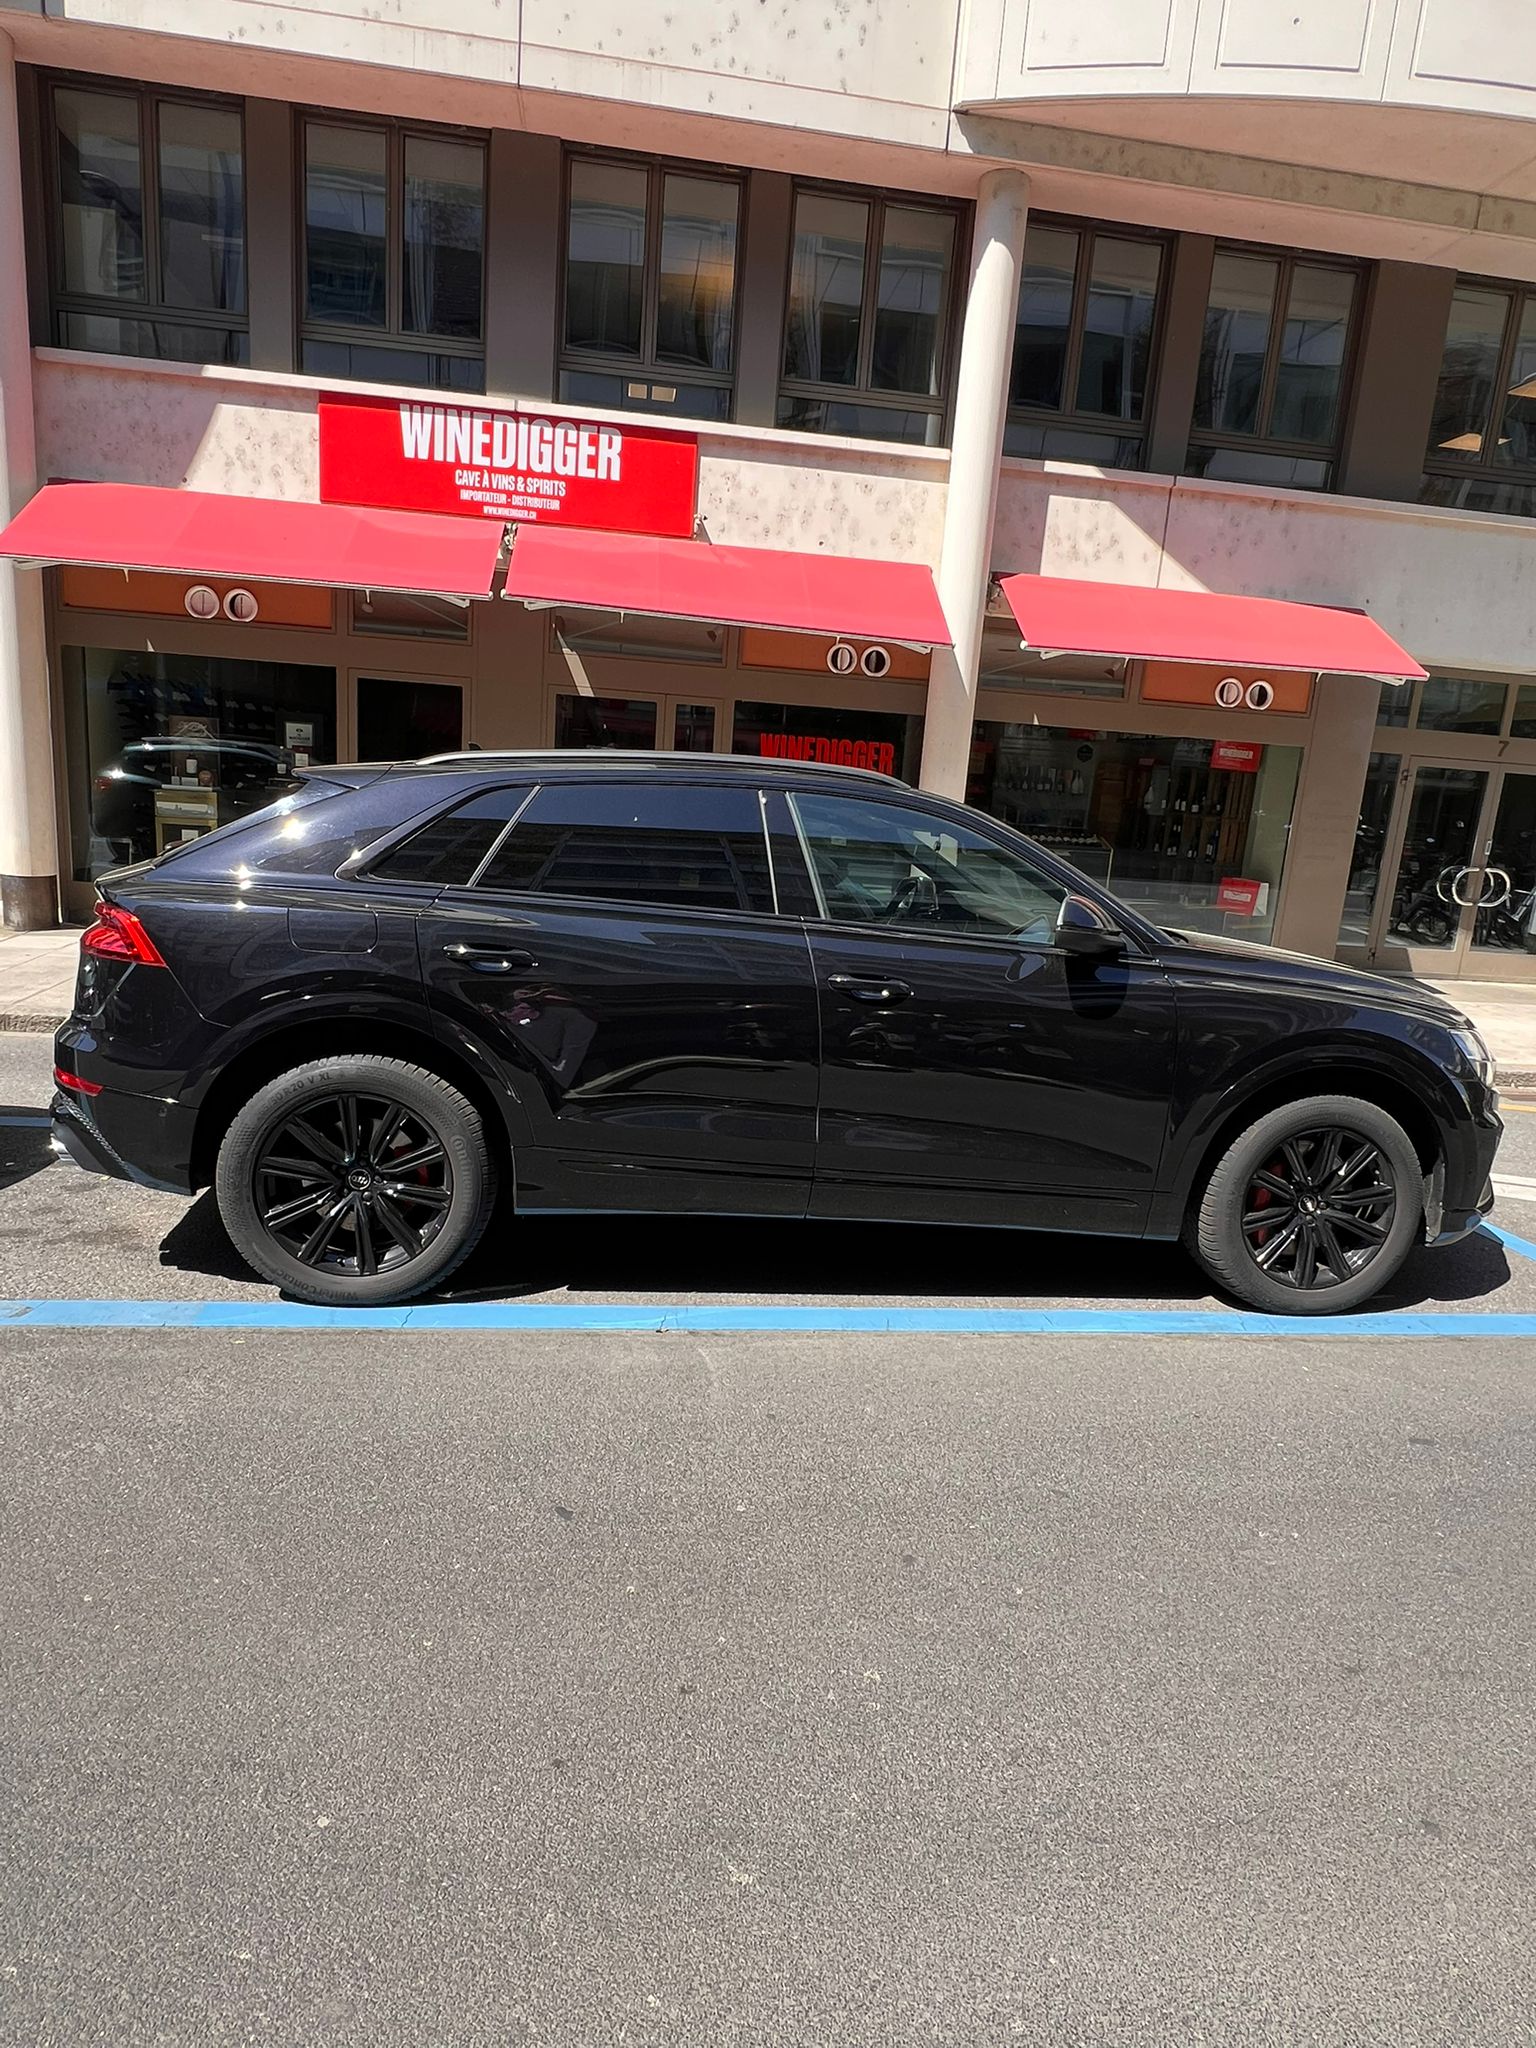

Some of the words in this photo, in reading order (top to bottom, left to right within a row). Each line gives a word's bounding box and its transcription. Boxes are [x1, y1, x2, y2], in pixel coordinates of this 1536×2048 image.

[400, 403, 622, 481] WINEDIGGER
[455, 469, 481, 487] CAVE
[482, 469, 490, 488] À
[491, 473, 515, 491] VINS
[516, 476, 525, 492] &
[526, 477, 566, 497] SPIRITS
[460, 489, 507, 505] IMPORTATEUR
[512, 494, 560, 511] DISTRIBUTEUR
[760, 733, 895, 776] WINEDIGGER
[1498, 740, 1510, 757] 7
